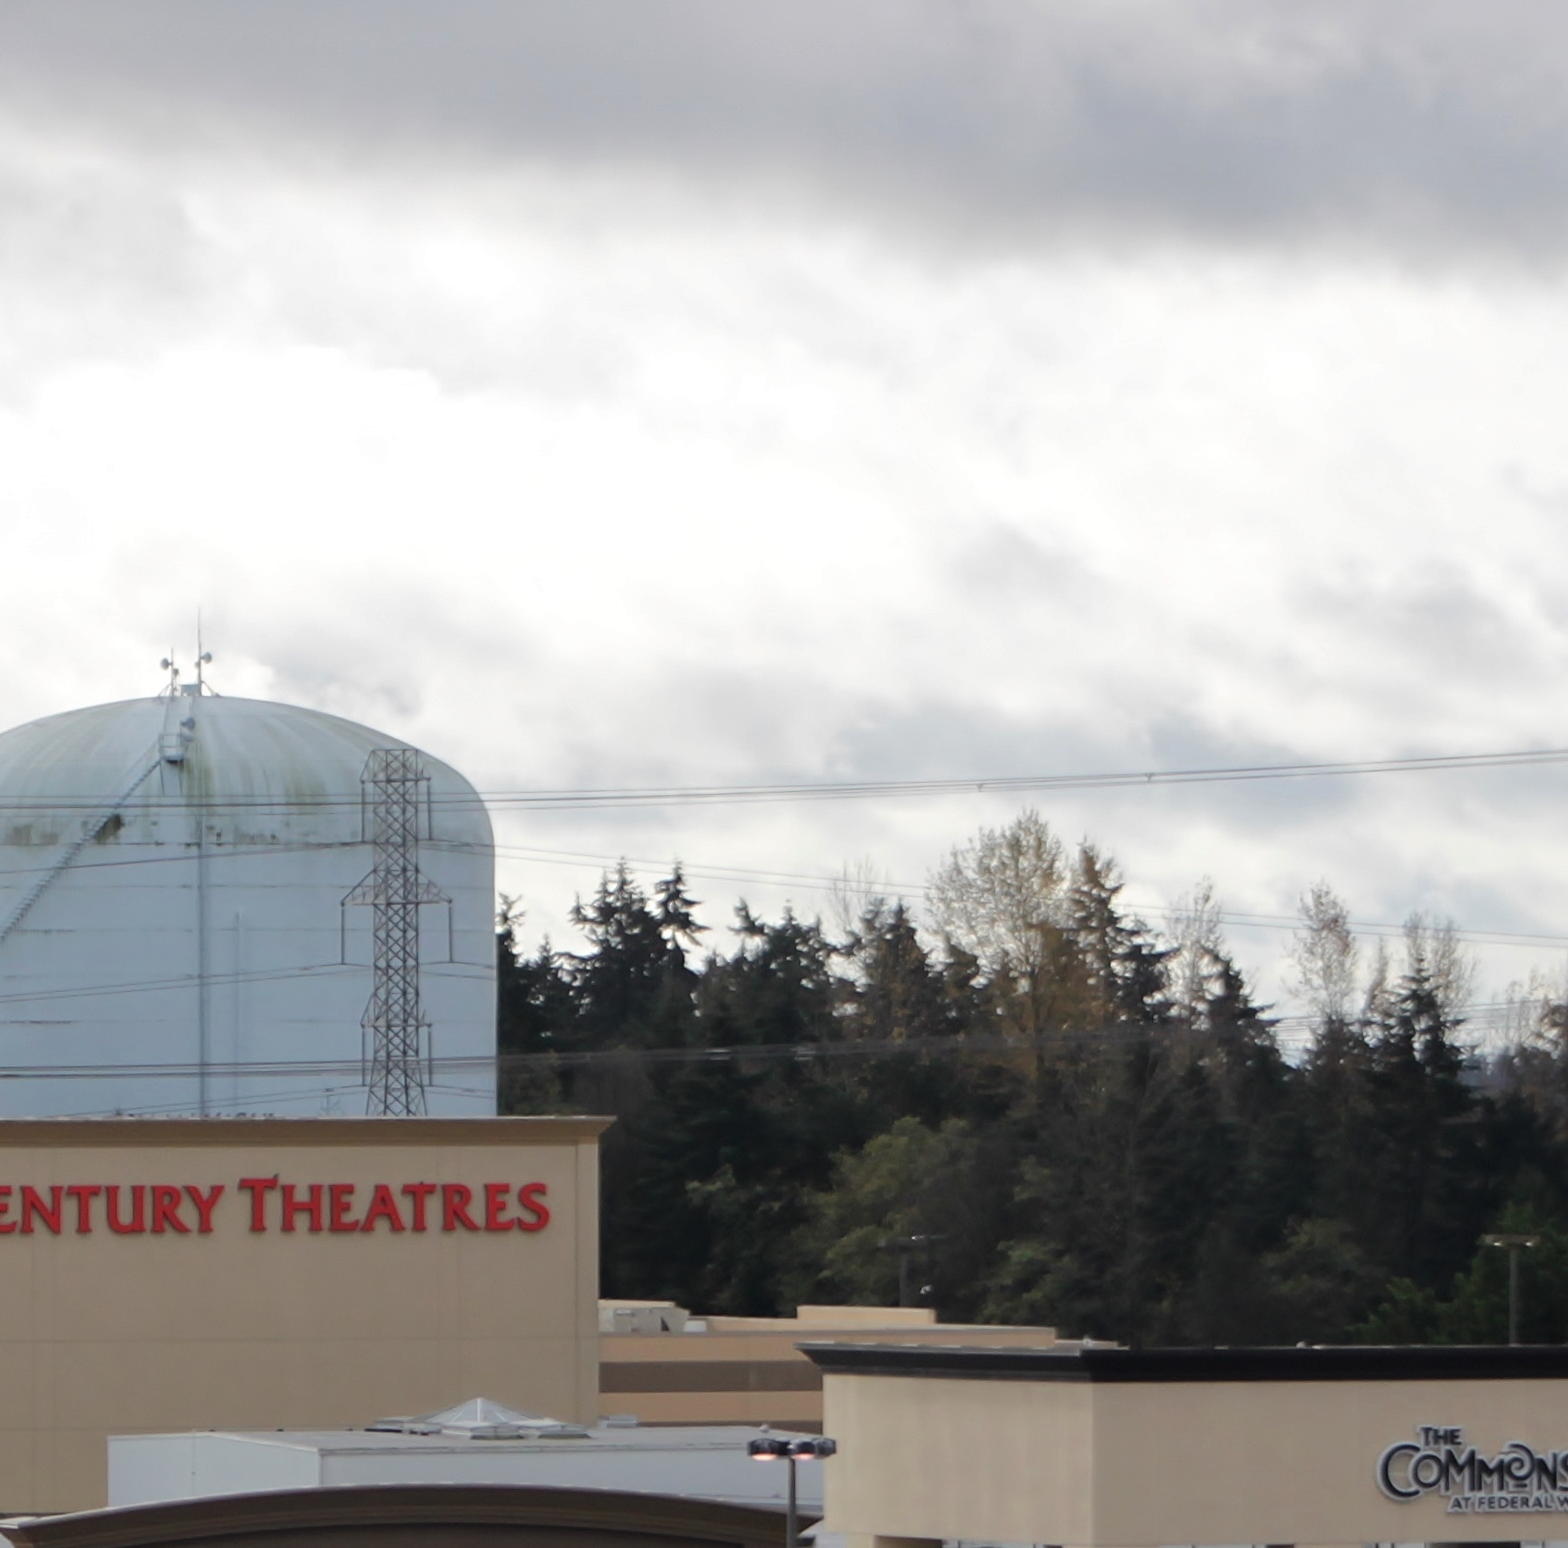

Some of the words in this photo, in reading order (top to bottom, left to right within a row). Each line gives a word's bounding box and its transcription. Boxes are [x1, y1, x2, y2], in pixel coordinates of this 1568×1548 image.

[238, 1175, 551, 1234] THEATRES
[1419, 1426, 1462, 1447] THE
[1450, 1496, 1474, 1511] AT
[1476, 1495, 1553, 1511] FEDERAL
